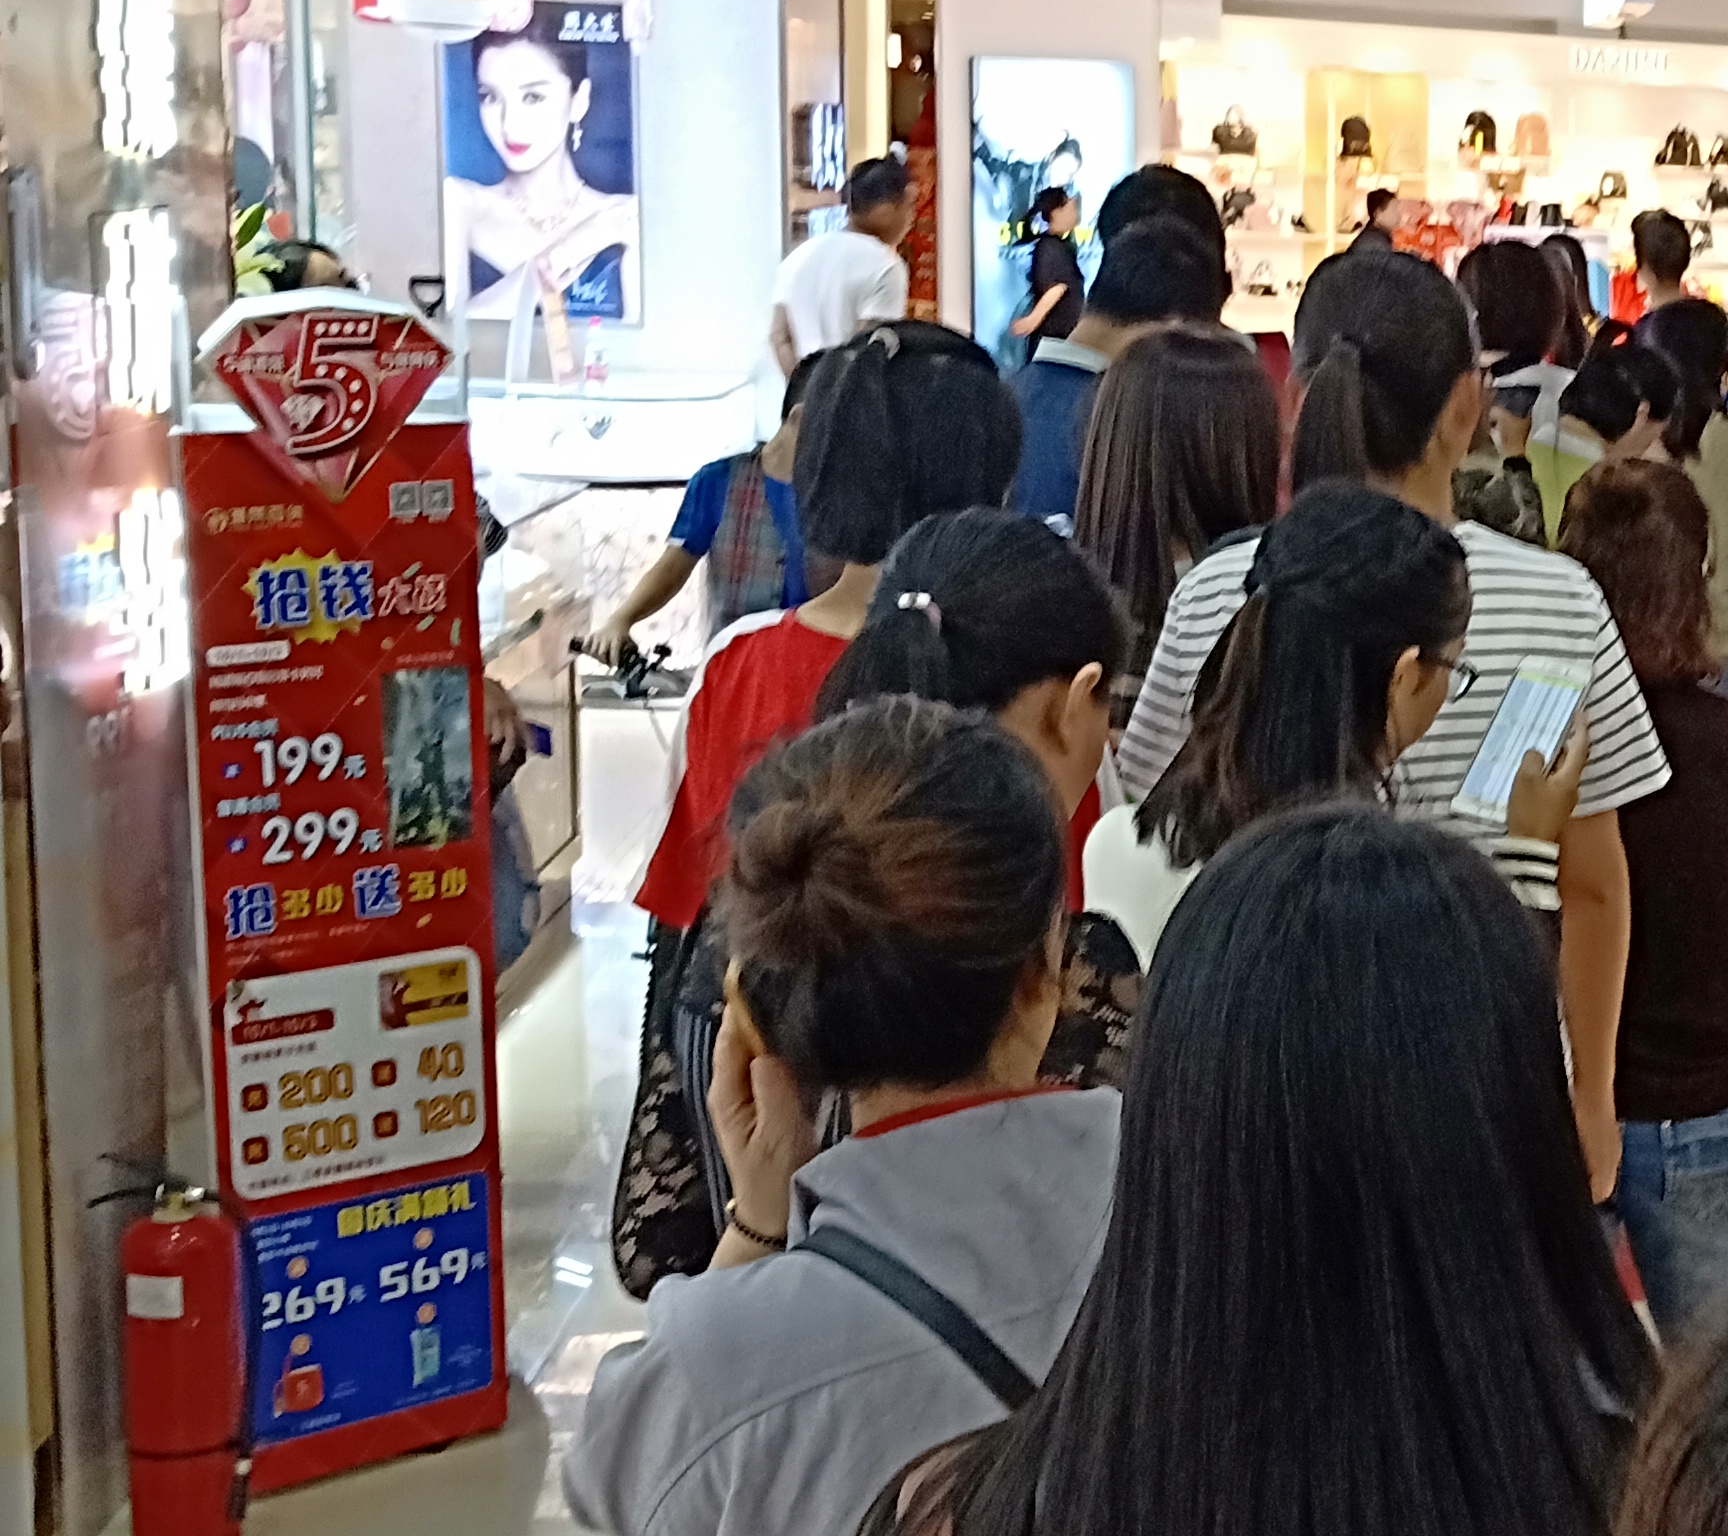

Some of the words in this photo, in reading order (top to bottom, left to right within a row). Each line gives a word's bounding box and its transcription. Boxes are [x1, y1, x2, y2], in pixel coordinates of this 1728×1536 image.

[286, 312, 380, 456] 5
[278, 1062, 355, 1111] 200
[417, 1041, 466, 1082] 40
[282, 1114, 359, 1162] 500
[414, 1089, 477, 1135] 120
